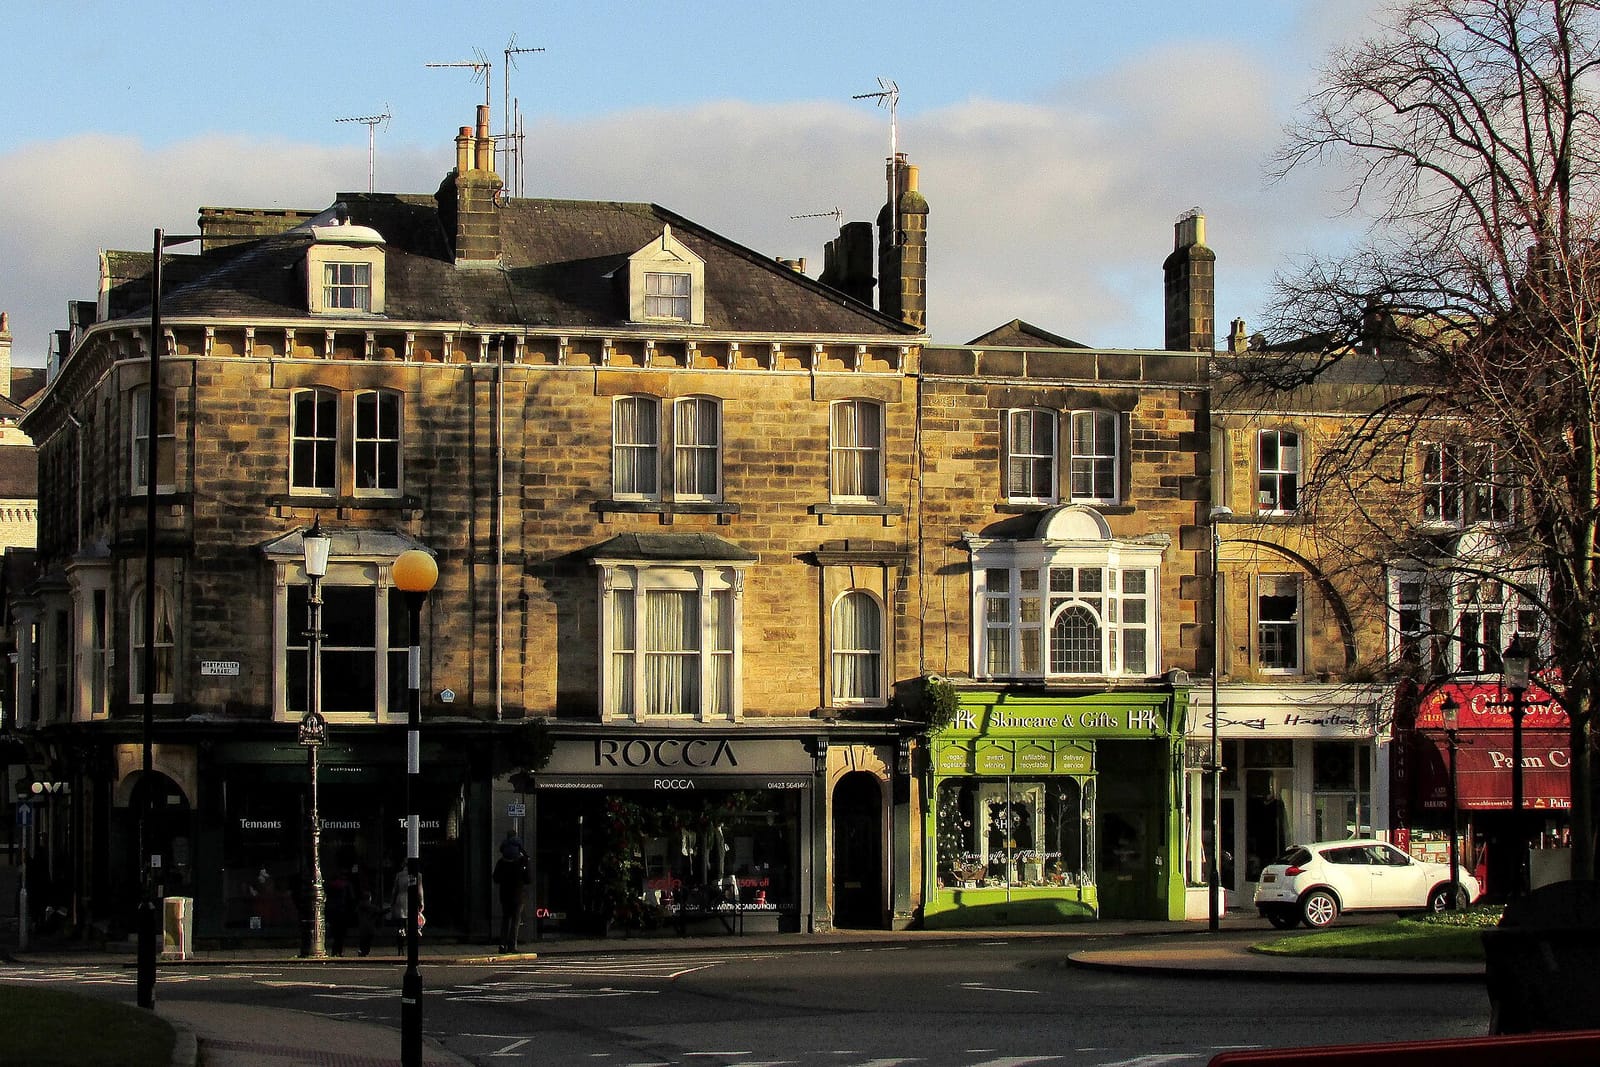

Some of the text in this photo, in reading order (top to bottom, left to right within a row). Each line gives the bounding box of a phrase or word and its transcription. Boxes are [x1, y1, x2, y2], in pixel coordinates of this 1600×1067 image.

[989, 711, 1058, 728] Skincare
[1063, 712, 1074, 728] &
[1080, 711, 1119, 728] Gifts
[1203, 711, 1359, 730] Suzy Hamilton
[594, 738, 738, 767] ROCCA
[1062, 754, 1085, 763] delivery
[653, 779, 695, 790] ROCCA
[239, 818, 282, 829] Tennants
[319, 818, 361, 829] Tennants
[397, 818, 440, 829] Teants
